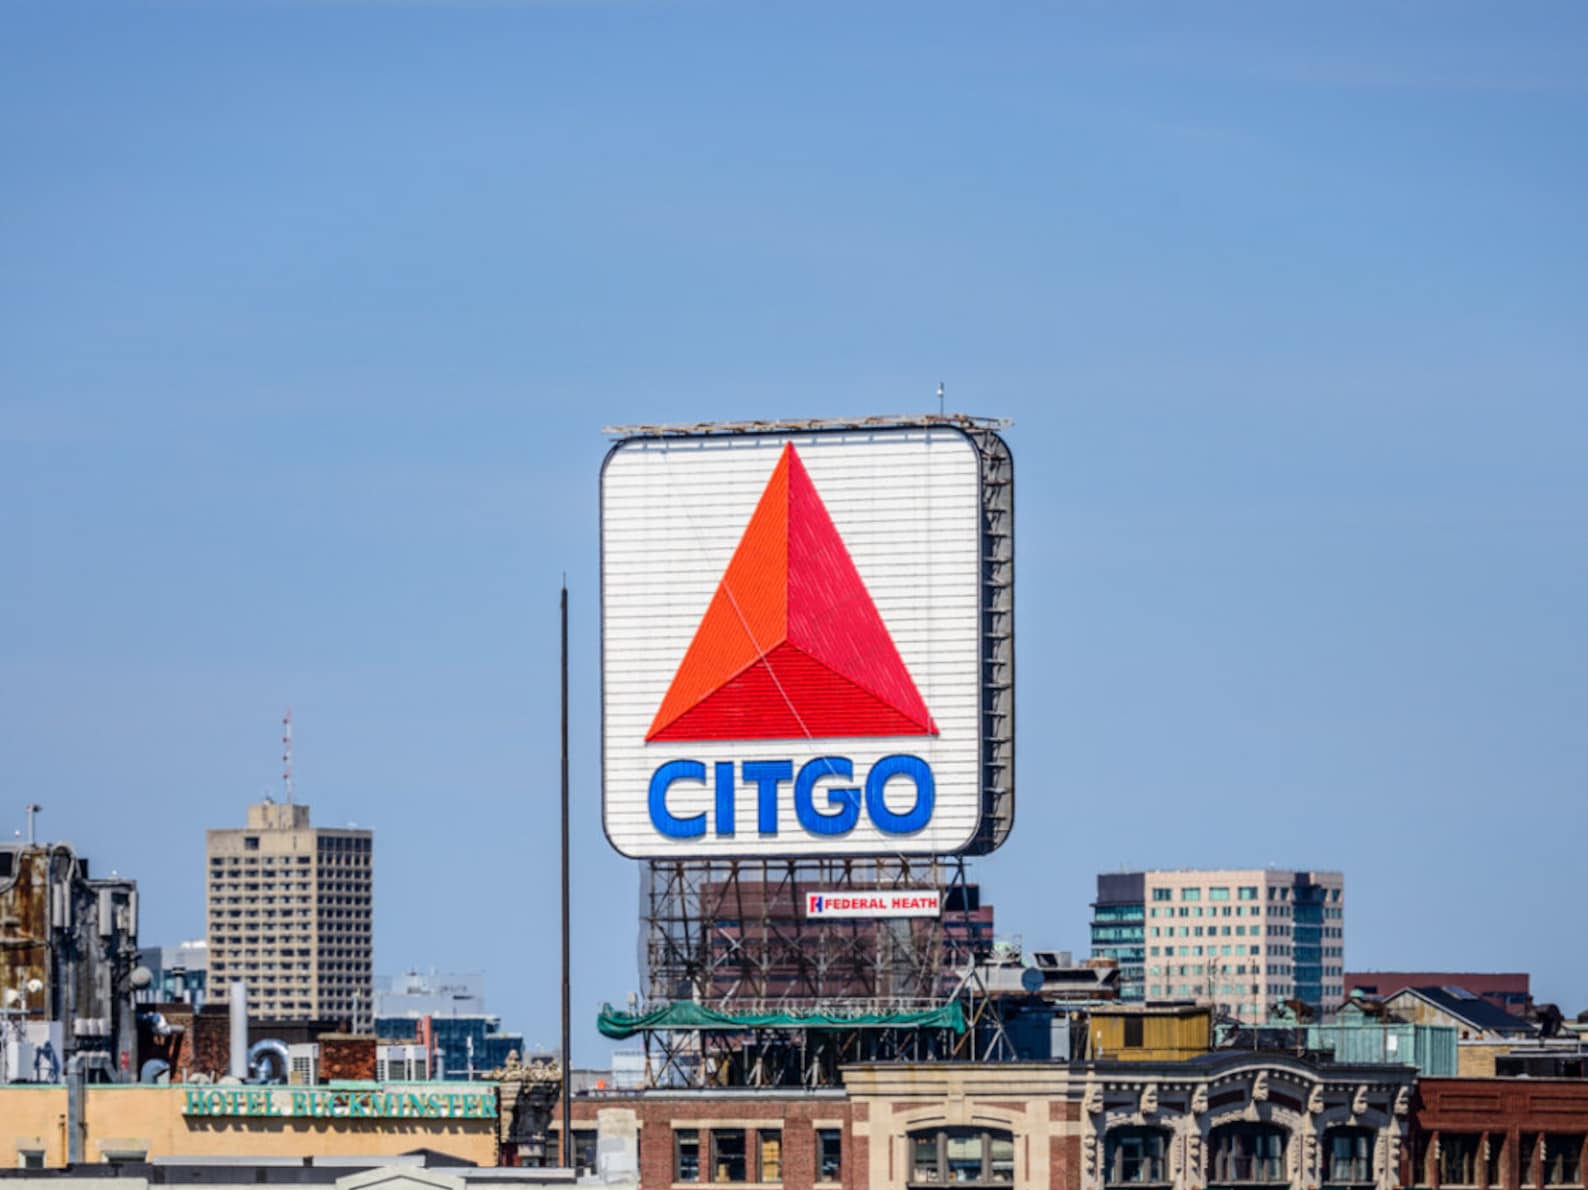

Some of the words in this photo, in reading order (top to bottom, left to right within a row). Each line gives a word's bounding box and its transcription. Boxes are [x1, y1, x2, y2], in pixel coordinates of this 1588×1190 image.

[647, 753, 936, 839] CITGO
[825, 898, 887, 909] FEDERAL
[892, 897, 937, 908] HEATH
[185, 1091, 281, 1116] HOTEL
[292, 1092, 498, 1118] BUCKMINSTER
